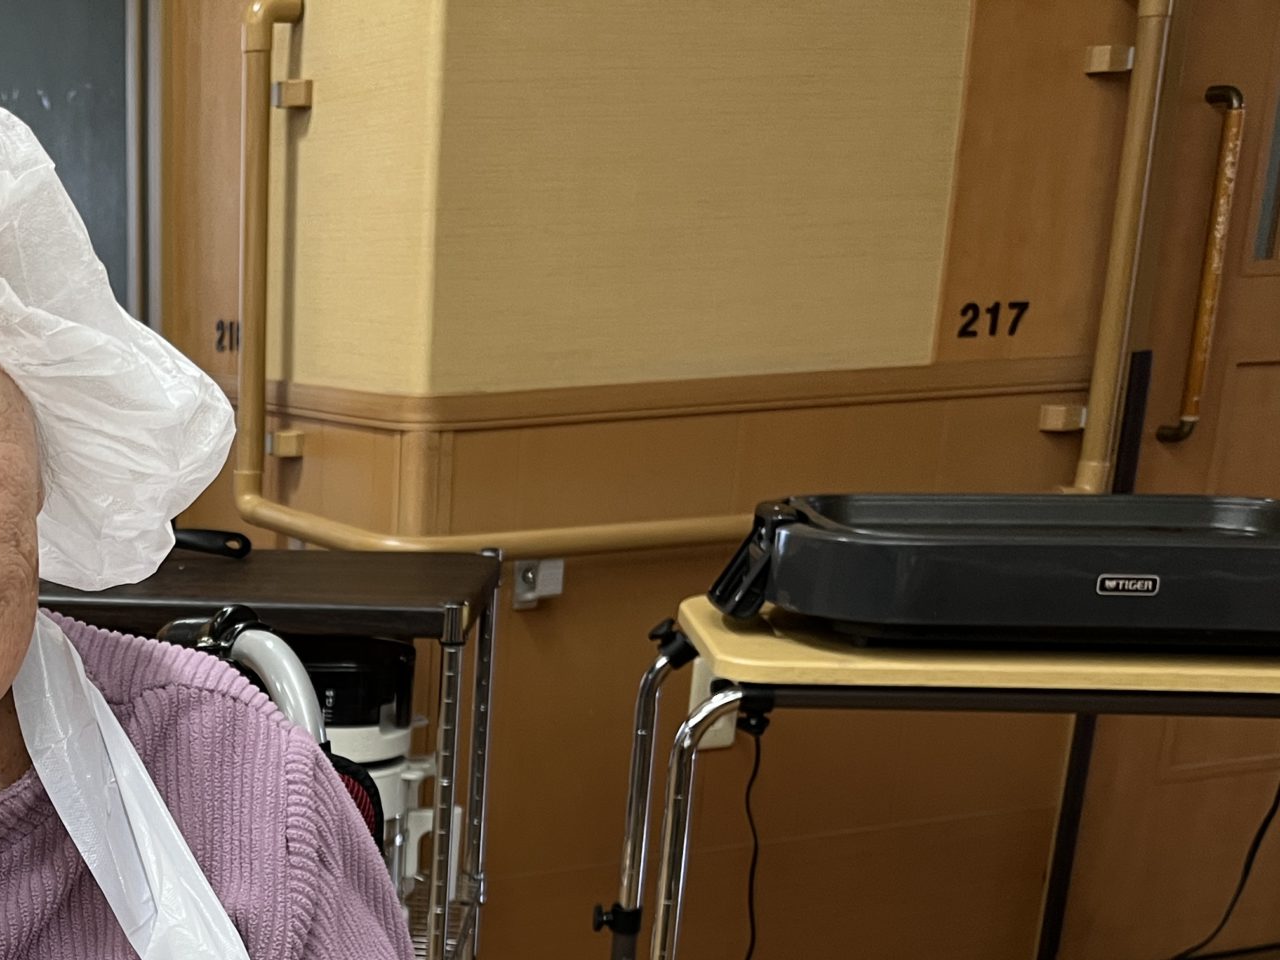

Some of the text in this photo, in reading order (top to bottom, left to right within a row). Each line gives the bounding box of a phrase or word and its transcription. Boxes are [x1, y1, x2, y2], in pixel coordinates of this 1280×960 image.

[215, 320, 239, 352] 21
[957, 302, 1029, 338] 217
[1118, 579, 1153, 590] TIGER
